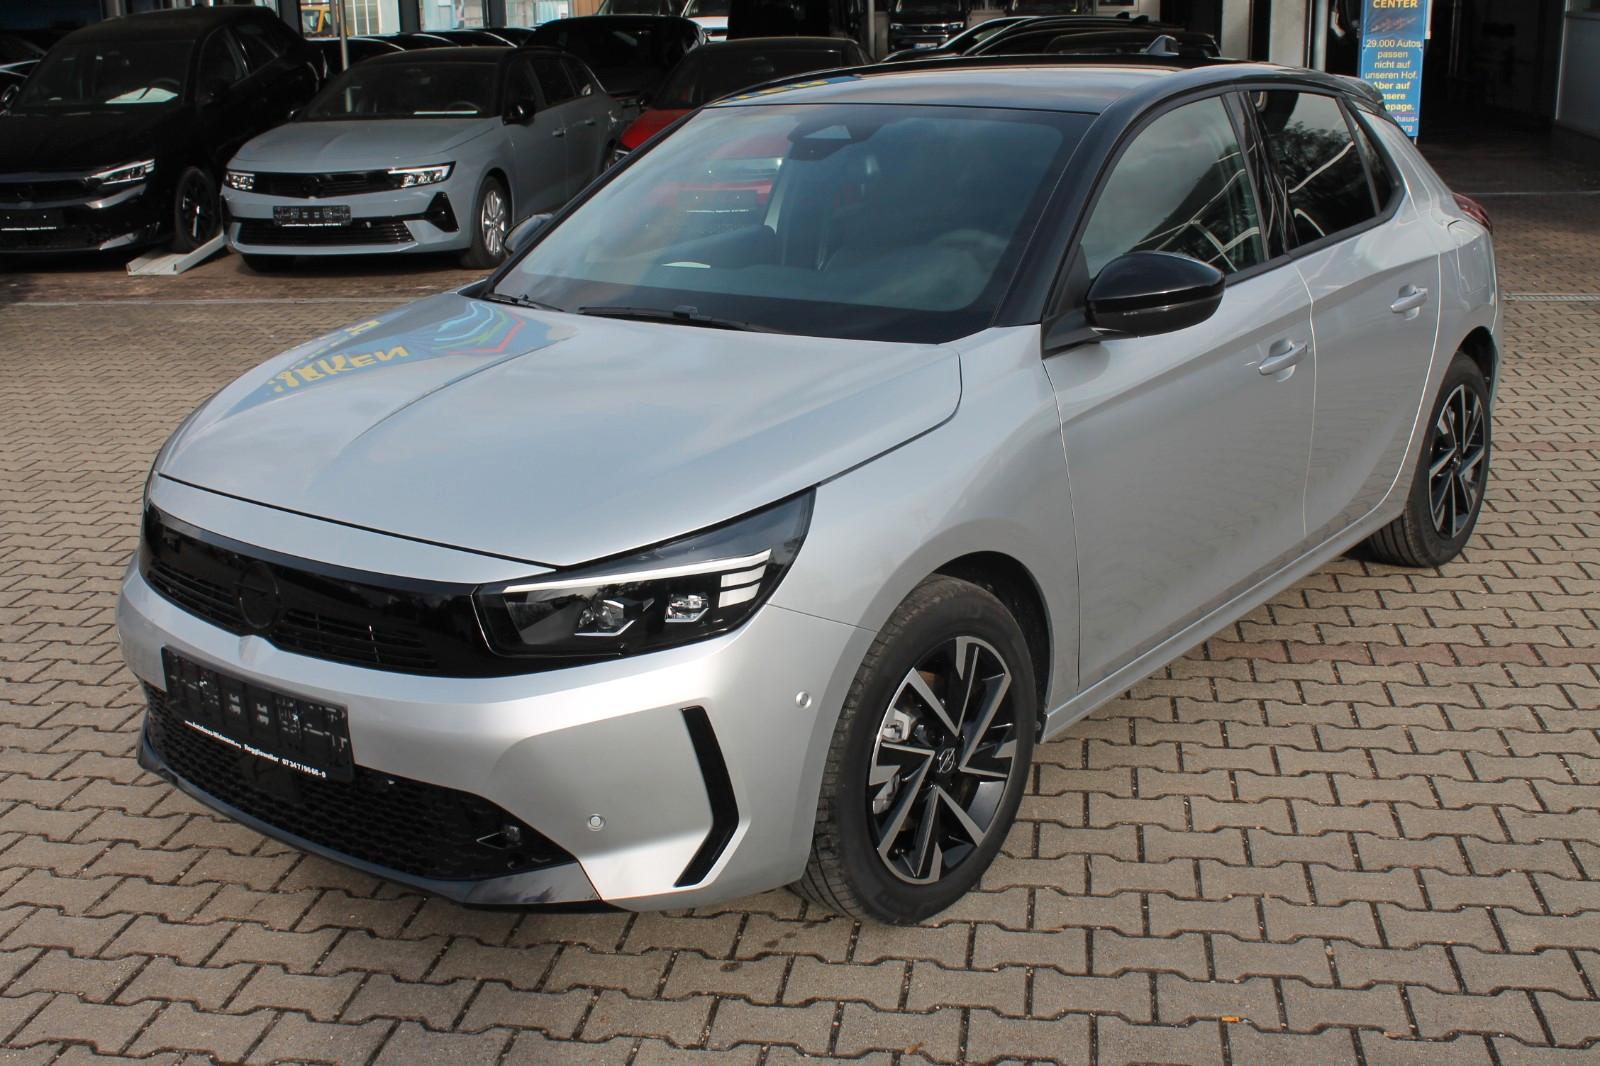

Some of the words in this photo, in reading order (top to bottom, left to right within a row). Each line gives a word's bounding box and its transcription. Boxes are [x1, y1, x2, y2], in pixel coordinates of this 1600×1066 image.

[1373, 0, 1418, 8] CENTER
[1396, 39, 1421, 48] Autos
[1377, 51, 1408, 60] passen
[1374, 60, 1395, 69] nicht
[1396, 60, 1410, 69] auf
[1395, 80, 1410, 89] auf
